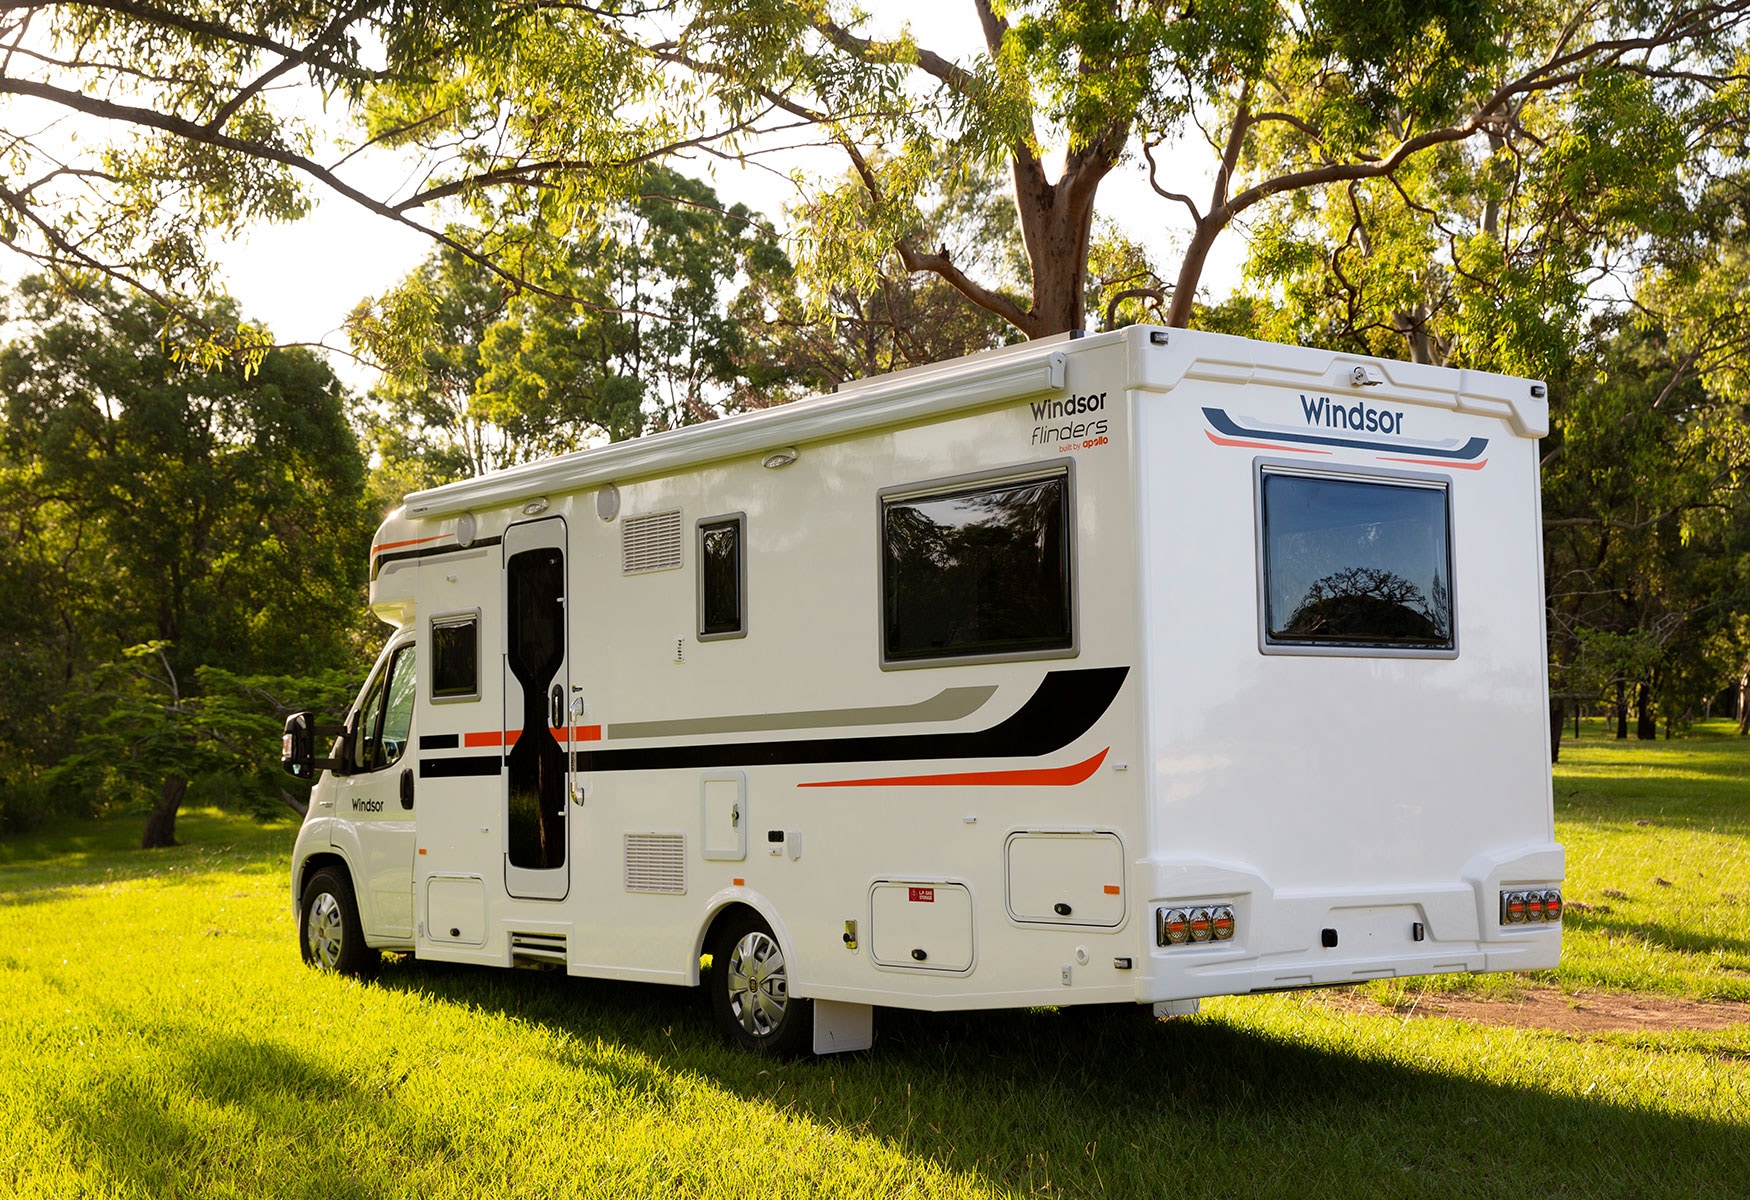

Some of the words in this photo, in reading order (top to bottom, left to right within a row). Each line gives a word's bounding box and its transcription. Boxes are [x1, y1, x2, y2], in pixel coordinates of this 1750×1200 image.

[1030, 392, 1107, 421] Windsor
[1300, 395, 1403, 434] Windsor
[1032, 420, 1108, 445] flinders
[1059, 444, 1072, 452] built
[1073, 443, 1081, 451] by
[1082, 436, 1109, 449] apollo
[351, 798, 384, 812] Windsor
